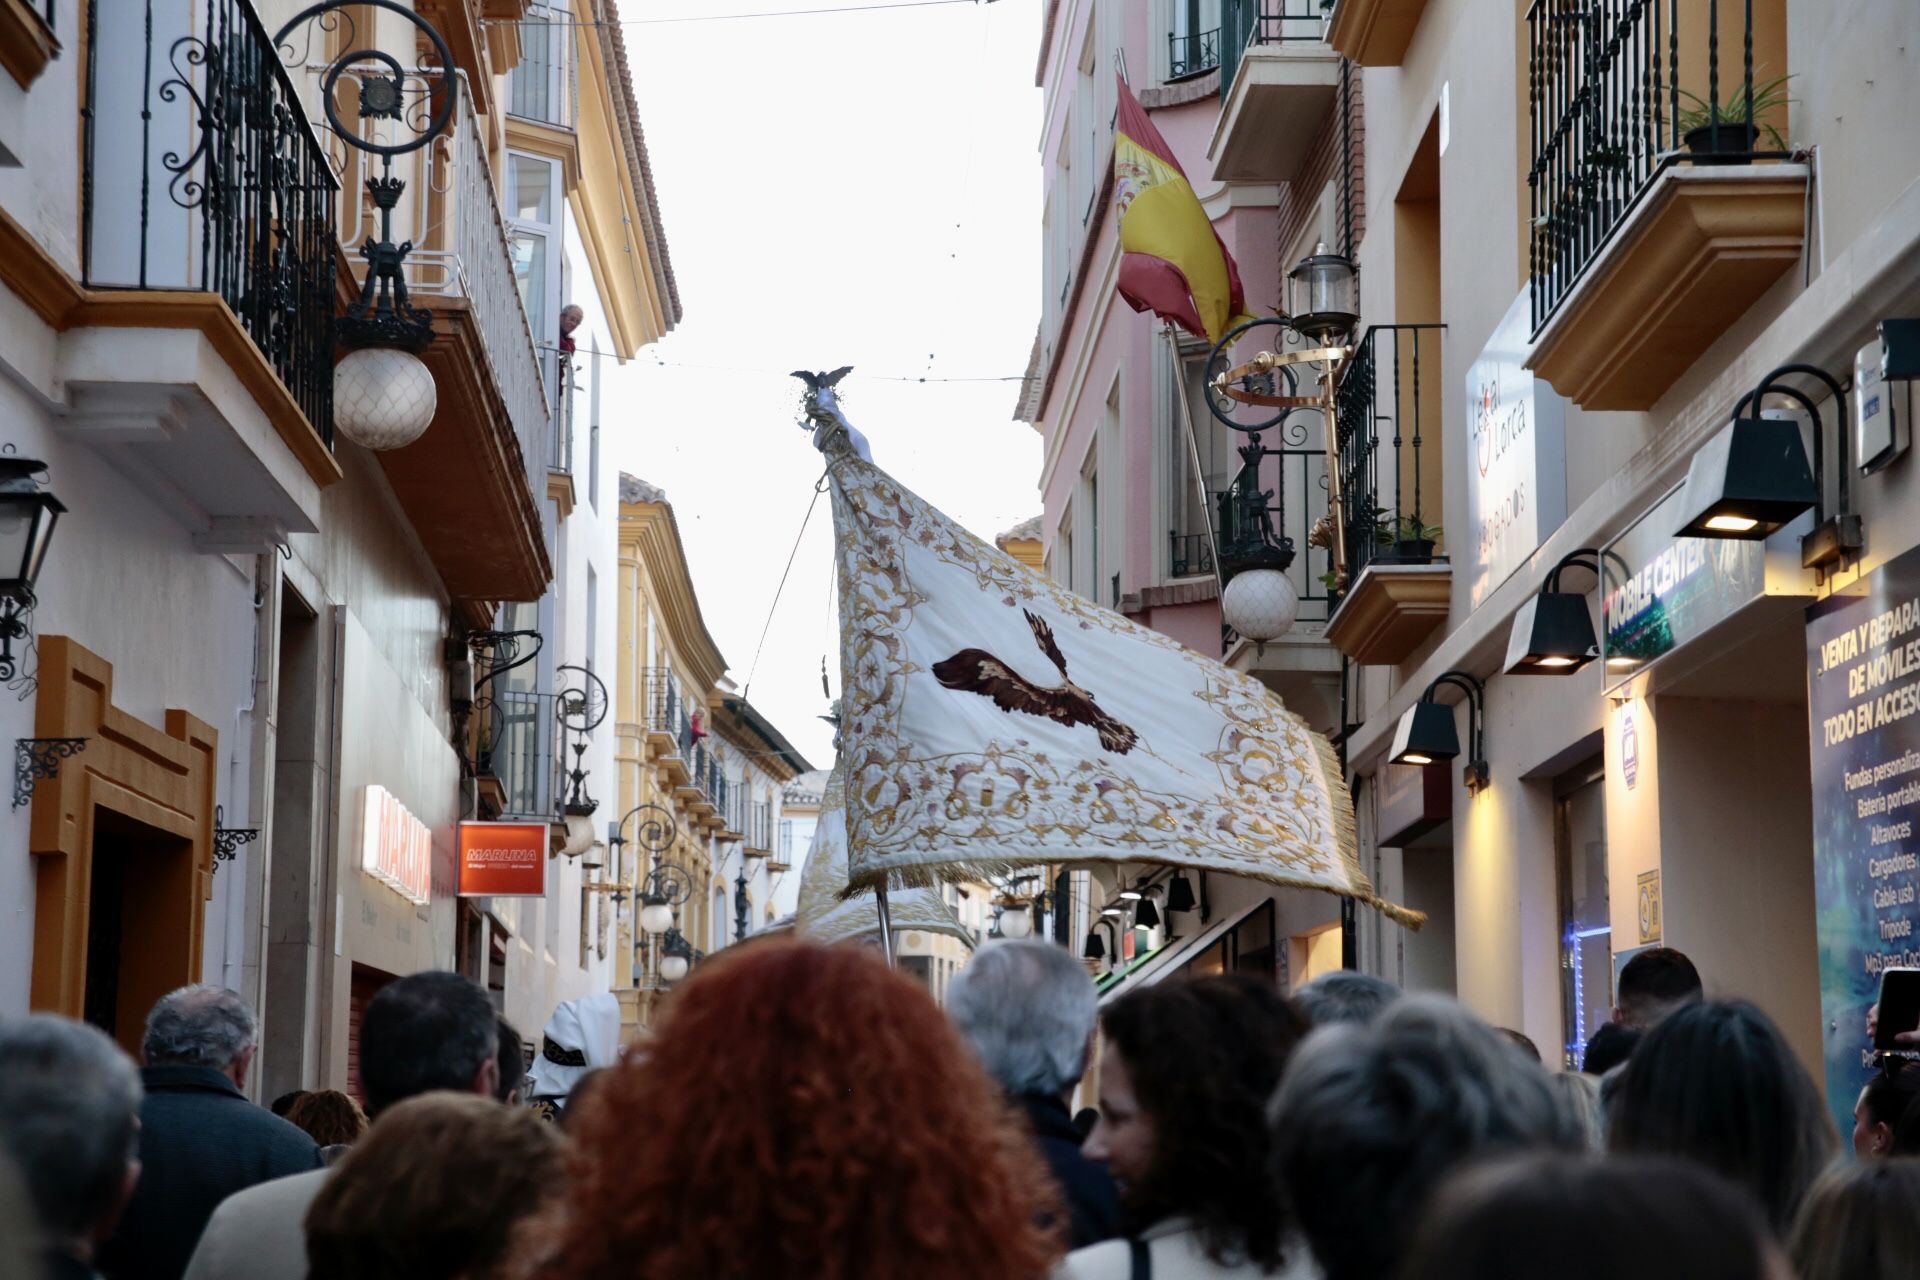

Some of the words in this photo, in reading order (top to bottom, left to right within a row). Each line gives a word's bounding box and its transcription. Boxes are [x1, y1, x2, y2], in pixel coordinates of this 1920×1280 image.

[1495, 399, 1526, 461] Lorca
[1608, 563, 1654, 634] MOBILE
[1653, 537, 1706, 598] CENTER
[1821, 628, 1858, 672] VENTA
[1859, 621, 1869, 654] Y
[1849, 664, 1865, 699] DE
[1823, 708, 1856, 748] TODO
[1856, 698, 1873, 735] EN
[1844, 766, 1873, 792] Fundas
[1857, 791, 1887, 819] Batería
[1871, 820, 1912, 846] Altavoces
[466, 848, 537, 862] MARLINA
[1869, 852, 1917, 880] Cargadores
[1874, 888, 1897, 909] Cable
[1898, 881, 1915, 904] usb
[1865, 953, 1882, 978] Mp3
